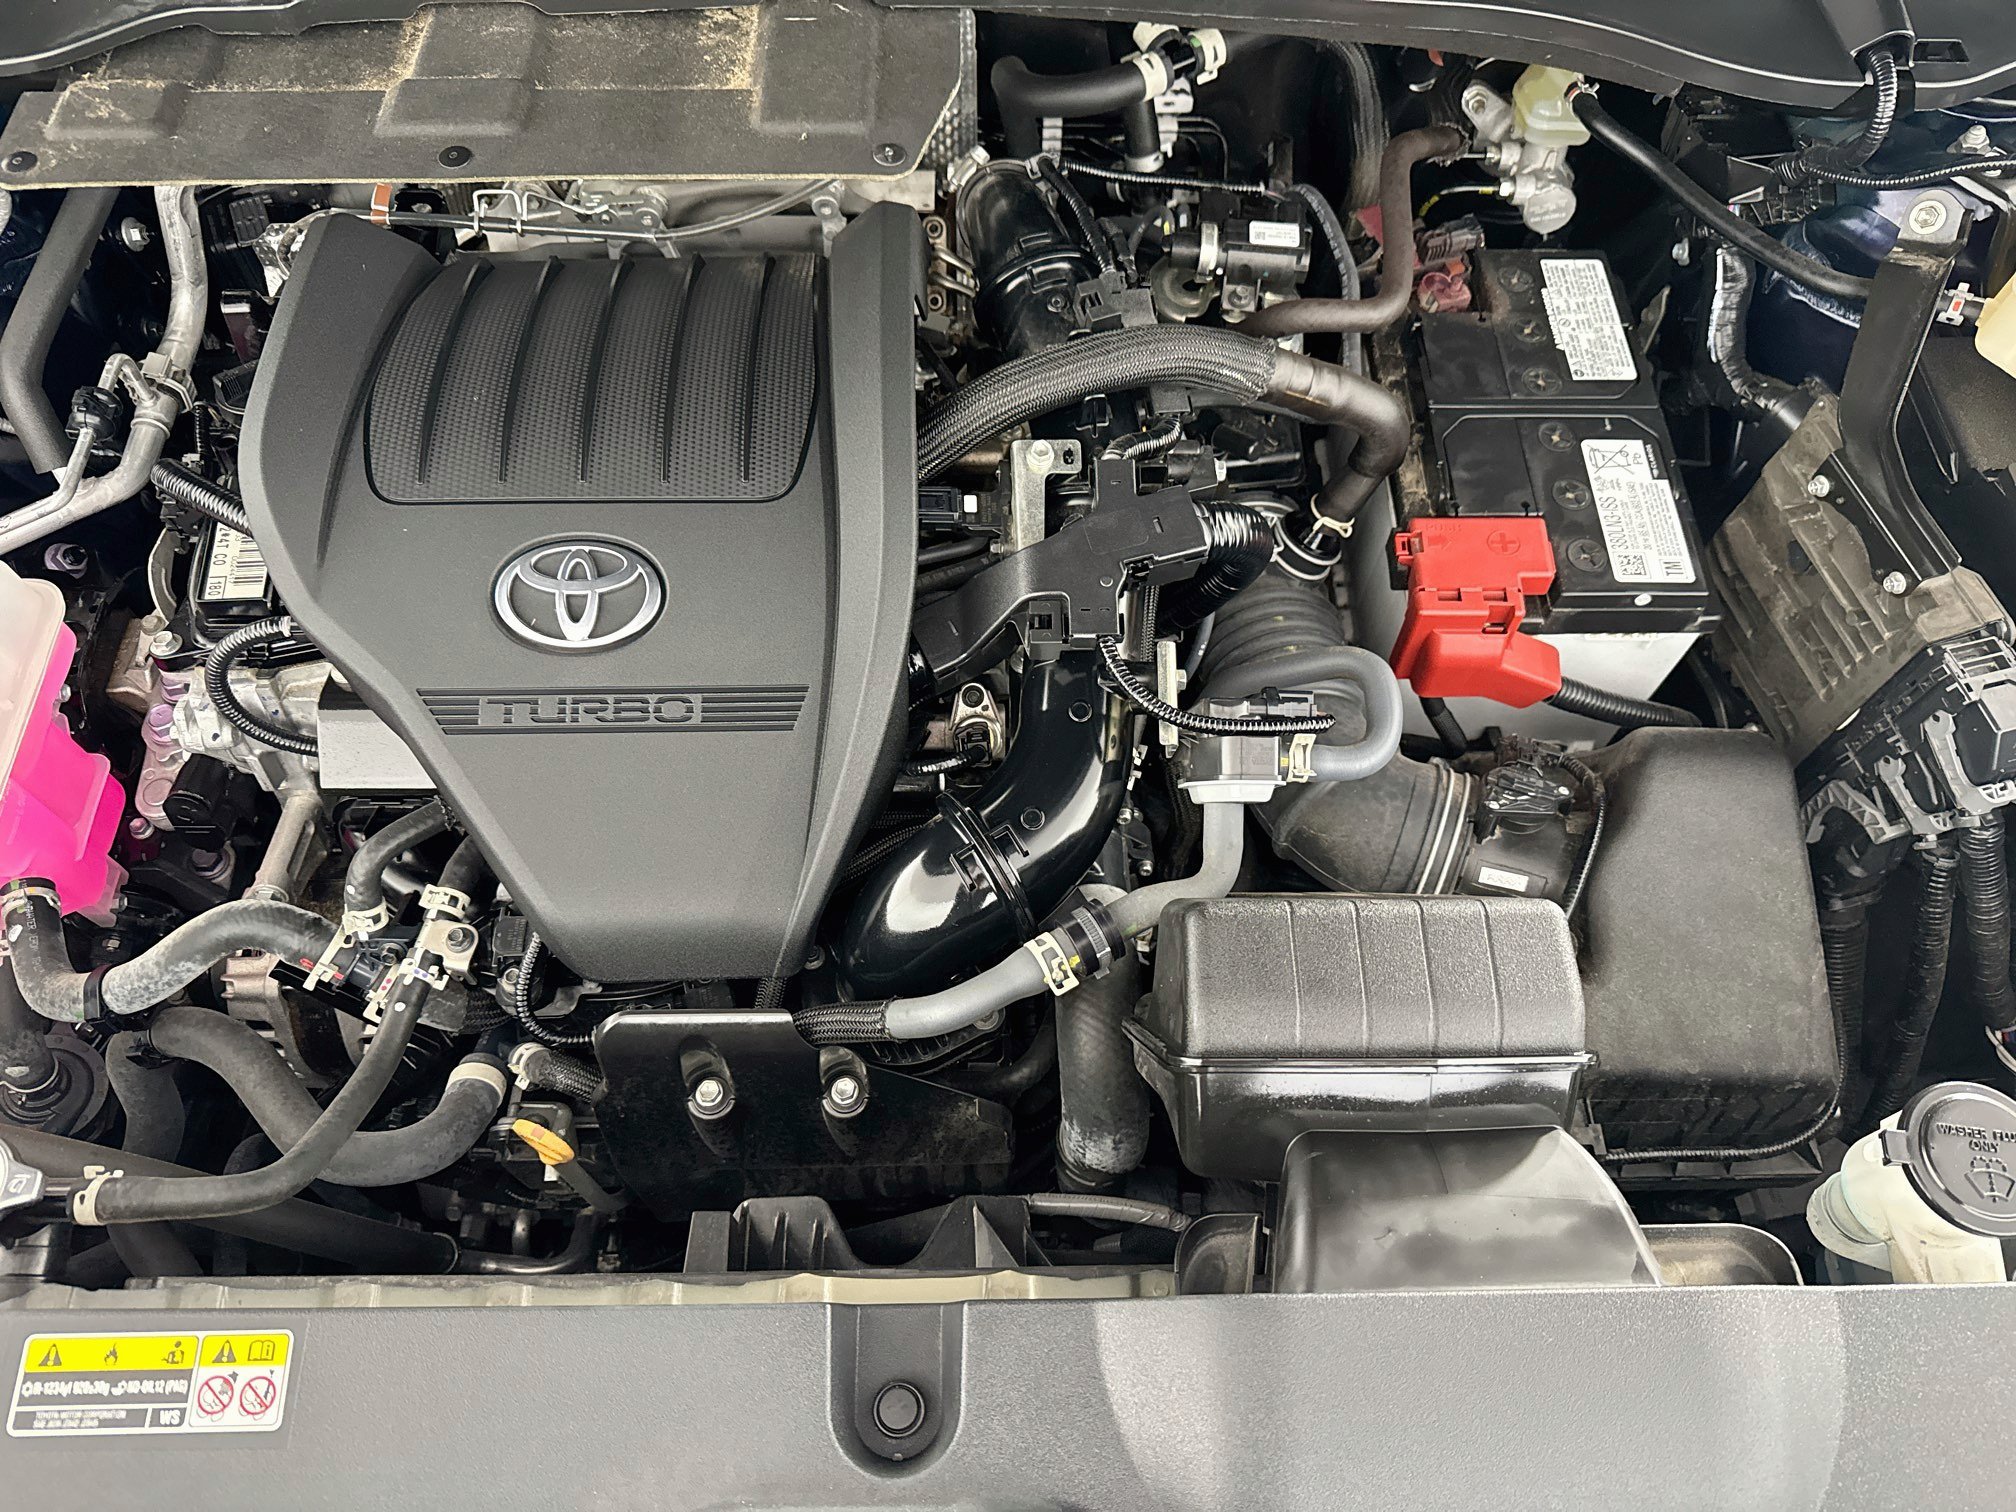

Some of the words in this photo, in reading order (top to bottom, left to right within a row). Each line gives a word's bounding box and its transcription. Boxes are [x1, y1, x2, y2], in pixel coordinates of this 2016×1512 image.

[1663, 561, 1685, 576] TM
[207, 581, 222, 596] 180
[486, 697, 694, 724] TURBO
[1935, 1122, 1987, 1140] WASHER
[1968, 1139, 2000, 1153] ONLY
[159, 1410, 181, 1425] WS
